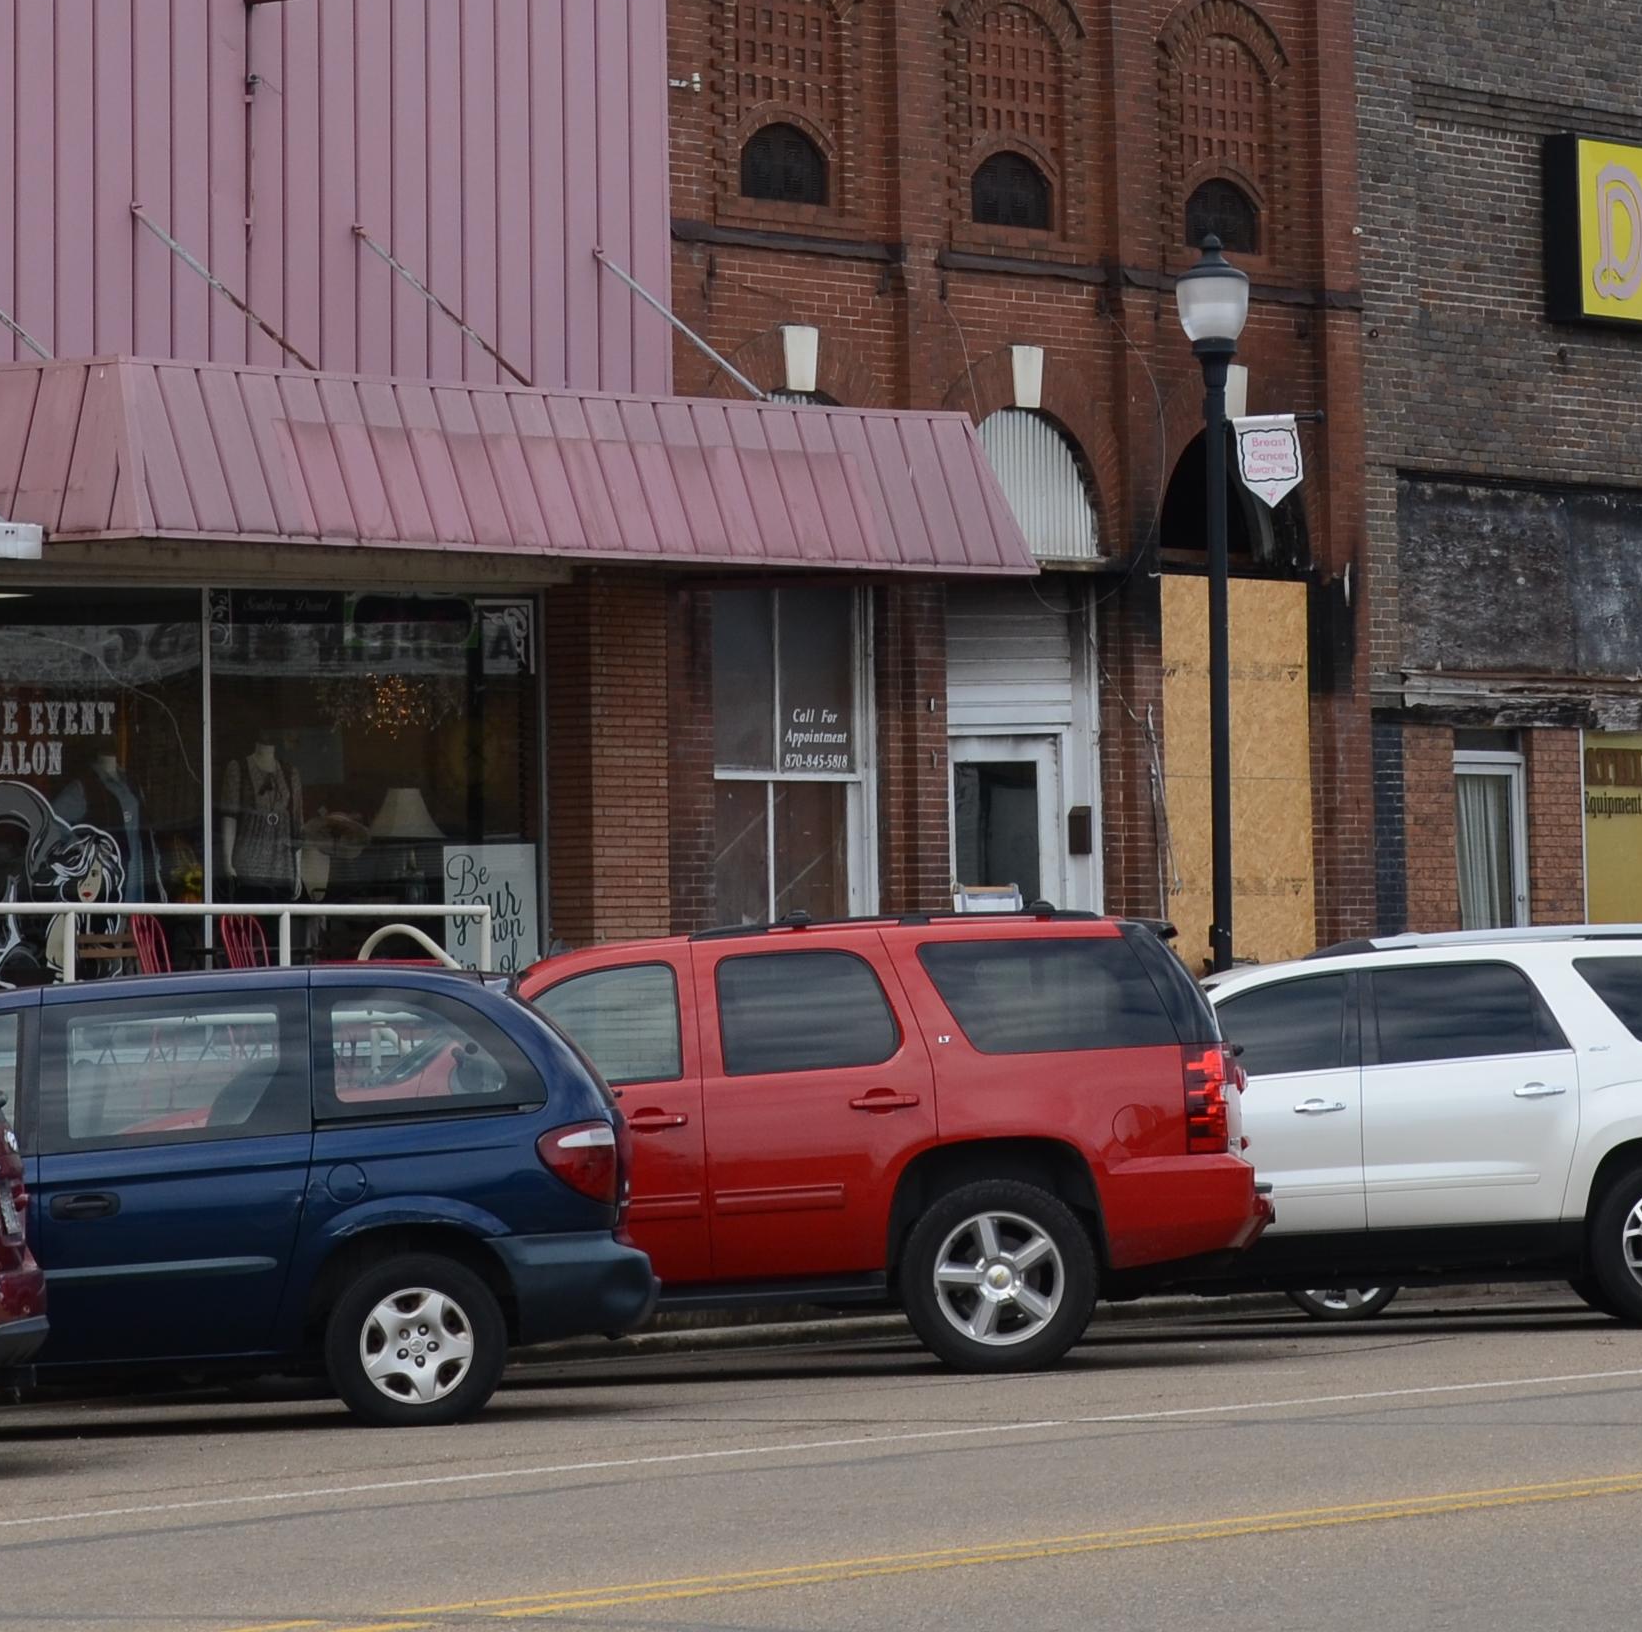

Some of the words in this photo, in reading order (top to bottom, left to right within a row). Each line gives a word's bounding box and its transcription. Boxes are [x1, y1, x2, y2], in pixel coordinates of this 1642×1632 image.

[1252, 437, 1287, 447] Breast
[1251, 451, 1289, 461] Cancer
[28, 700, 116, 736] EVENT
[792, 708, 815, 724] Call
[821, 709, 838, 724] For
[785, 728, 847, 748] Appointment
[1585, 790, 1642, 819] Equipment
[446, 853, 490, 897] Be
[492, 918, 525, 943] wn
